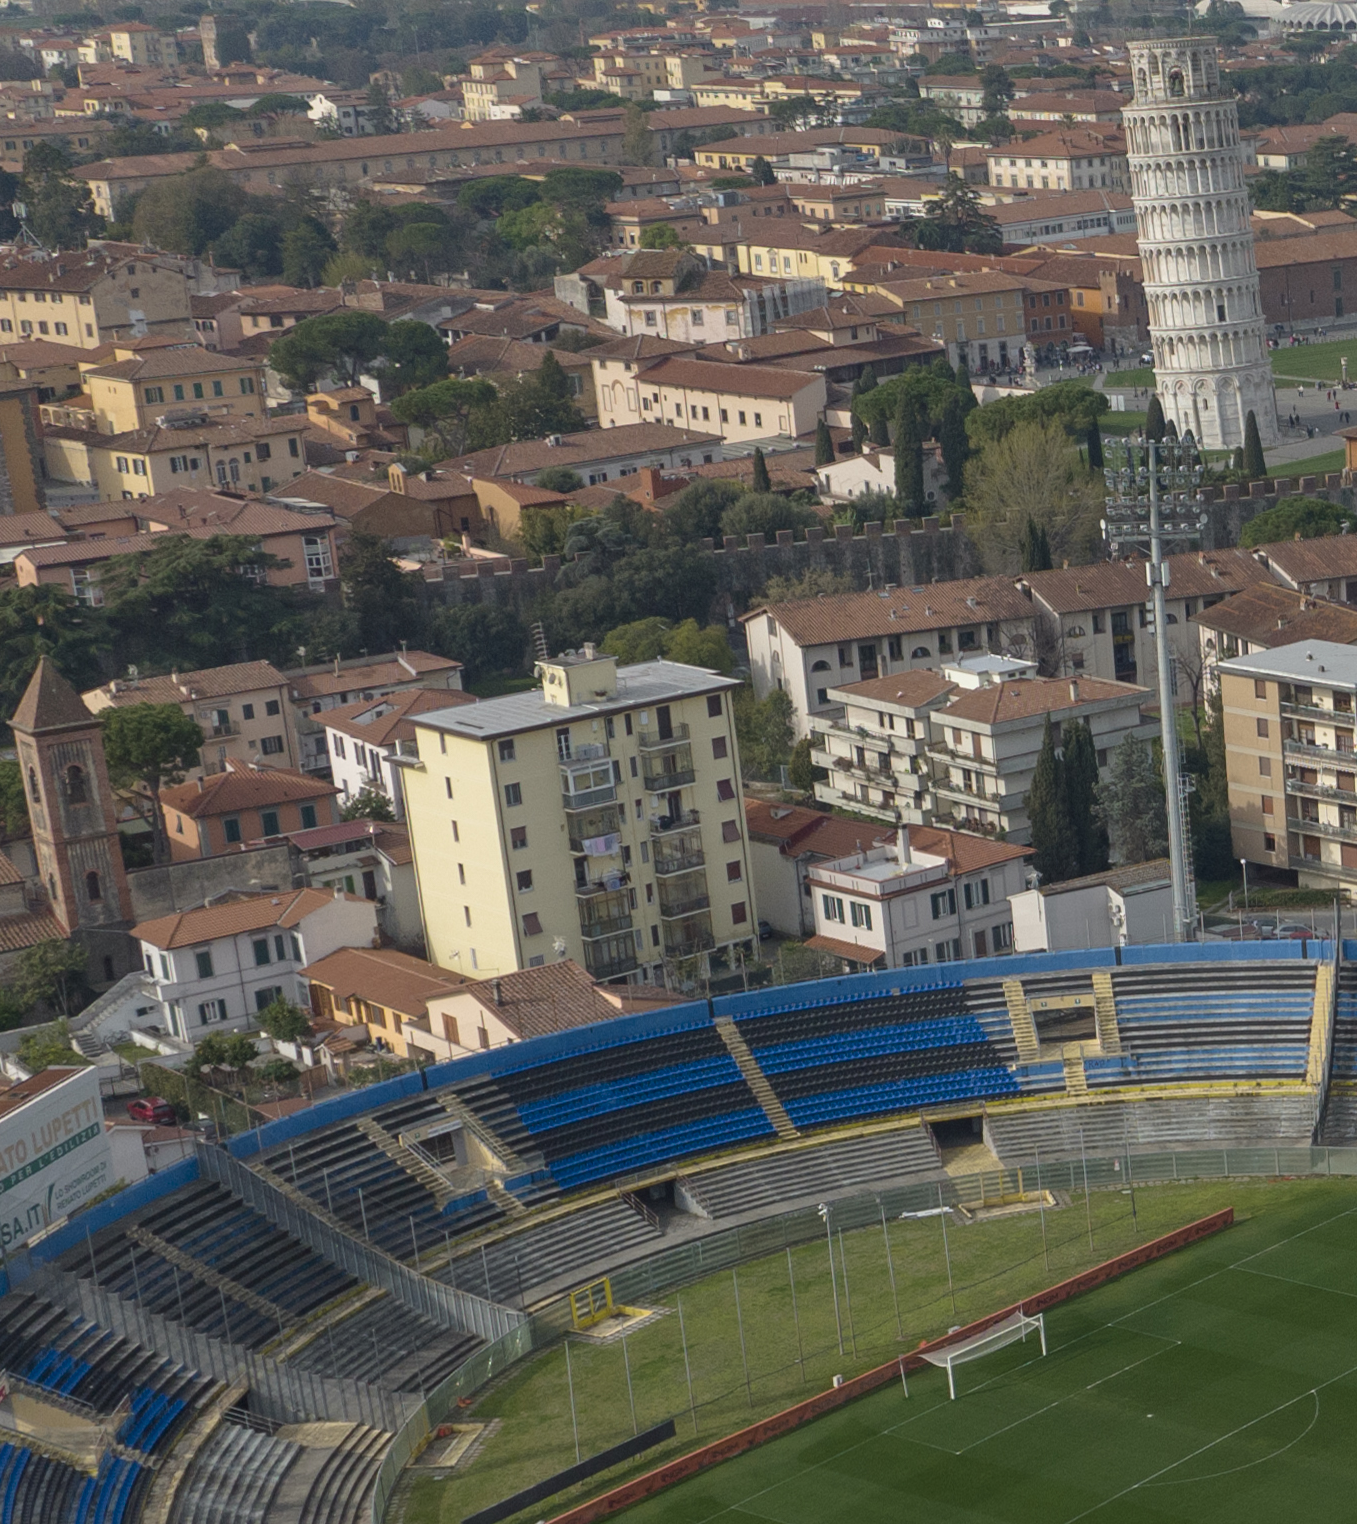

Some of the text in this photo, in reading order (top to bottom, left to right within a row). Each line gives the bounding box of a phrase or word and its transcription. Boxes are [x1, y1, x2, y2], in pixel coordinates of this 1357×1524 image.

[31, 1096, 98, 1154] LUPETTI
[11, 1165, 32, 1185] PER
[39, 1125, 99, 1169] L'EDILIZIA
[55, 1189, 63, 1200] LO
[64, 1167, 99, 1194] SHOWROOM
[57, 1174, 107, 1209] RENATO LUPETTI
